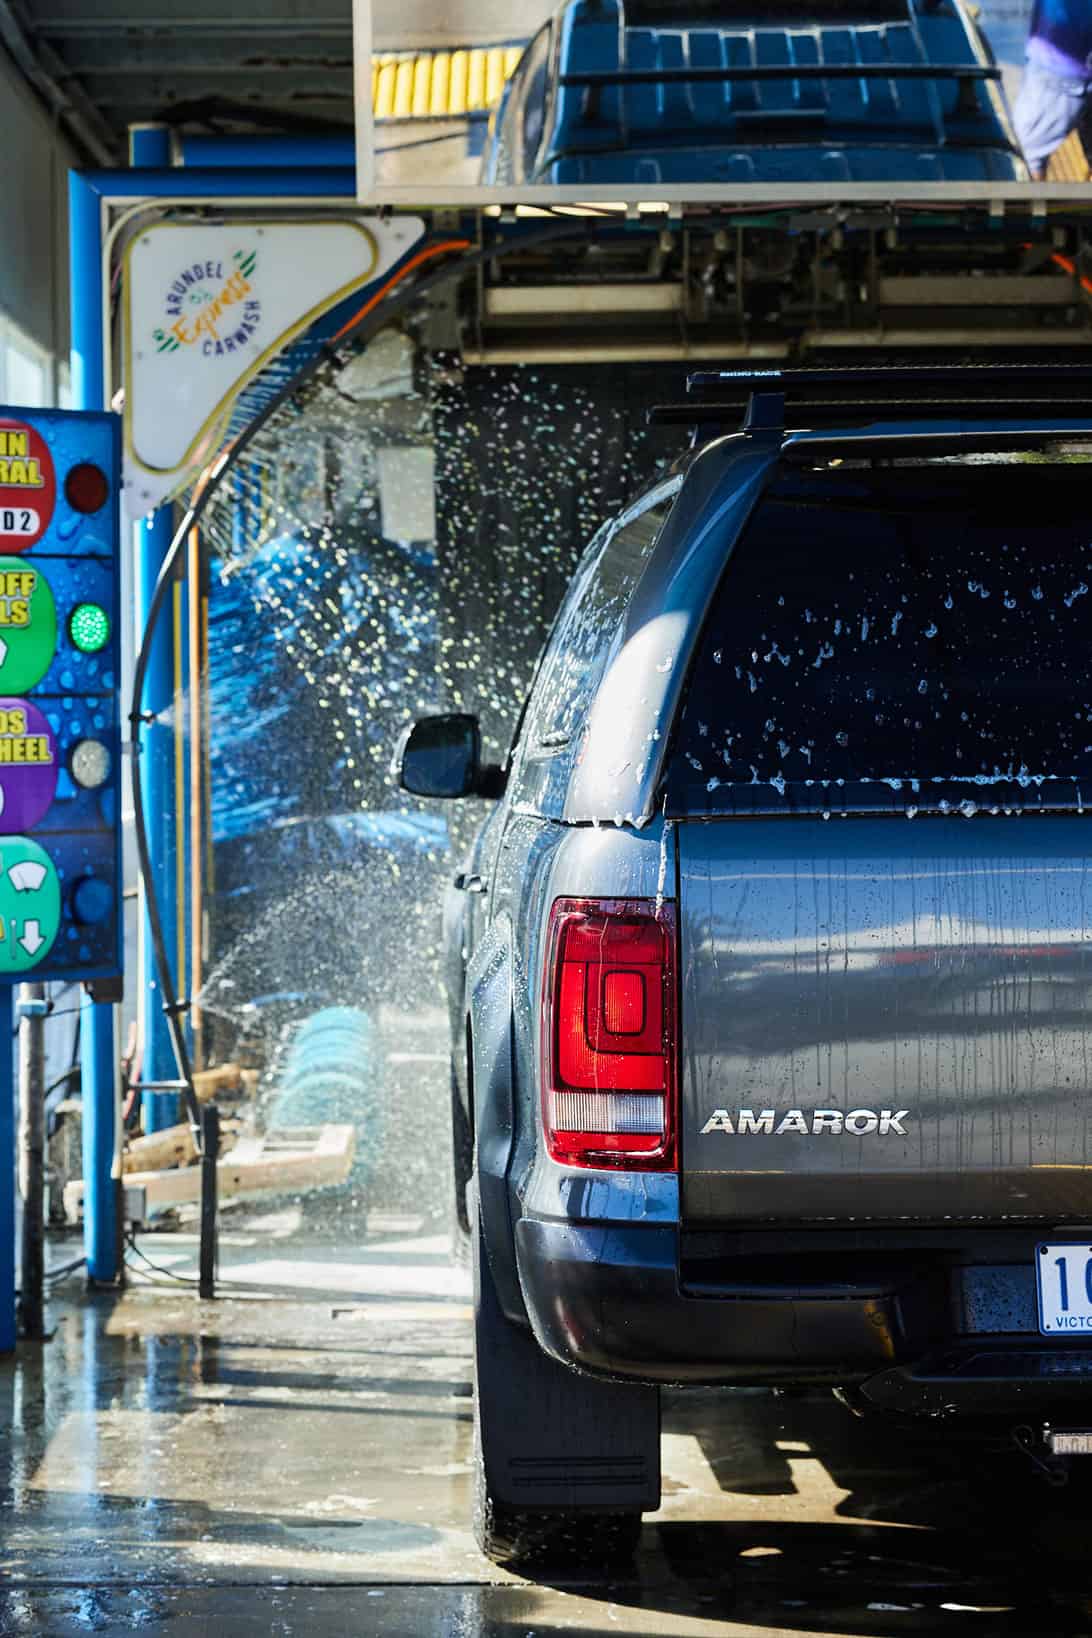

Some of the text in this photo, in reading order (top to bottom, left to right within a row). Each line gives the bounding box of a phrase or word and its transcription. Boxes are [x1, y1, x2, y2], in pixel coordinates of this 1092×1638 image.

[167, 261, 222, 316] ARUNDEL
[171, 271, 251, 344] Express
[202, 300, 260, 355] CARWASH
[700, 1109, 910, 1136] AMAROK
